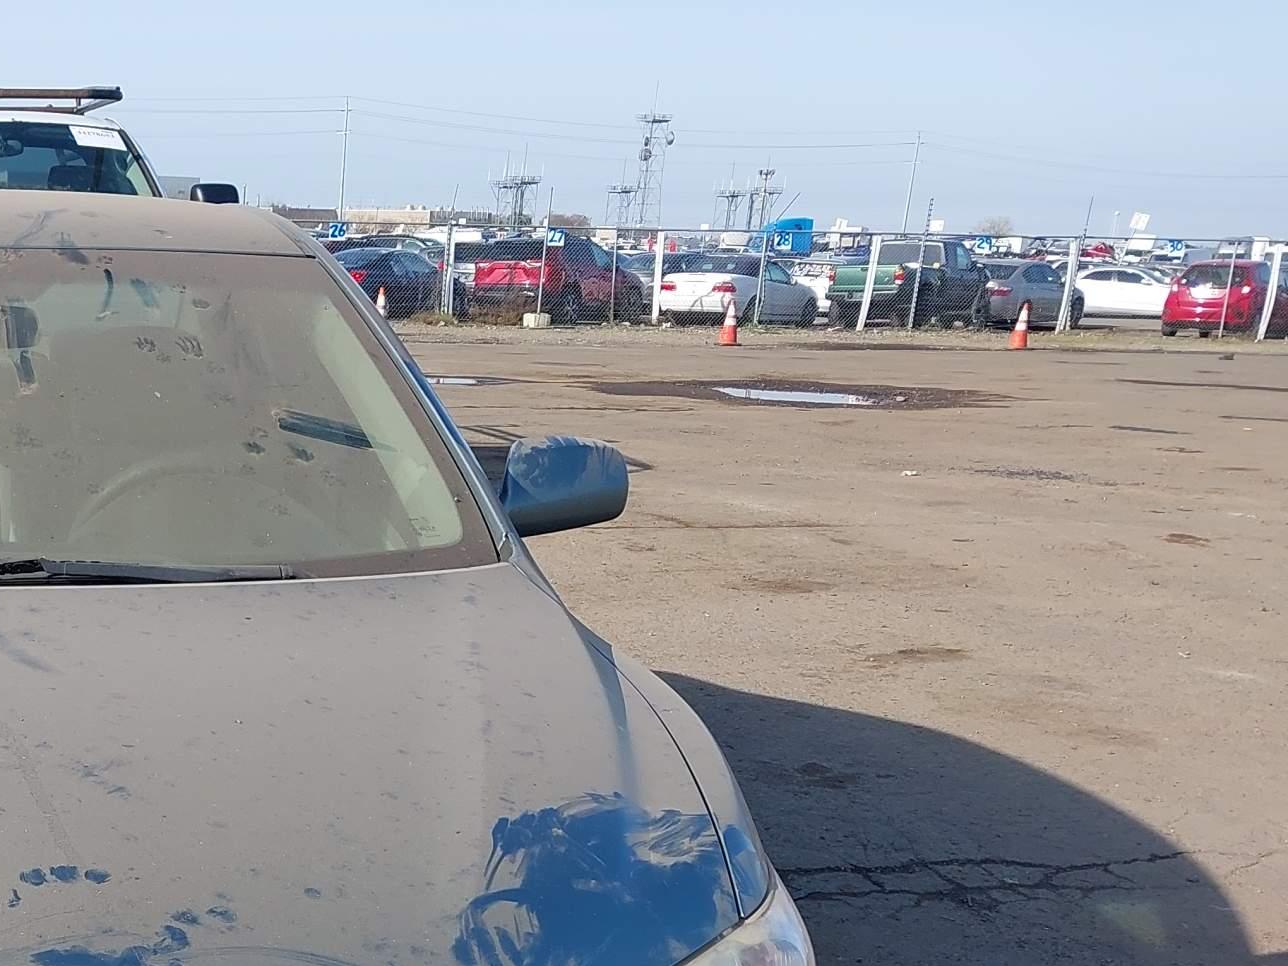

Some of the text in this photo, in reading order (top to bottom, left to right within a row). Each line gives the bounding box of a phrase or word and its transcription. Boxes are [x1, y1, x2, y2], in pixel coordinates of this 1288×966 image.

[330, 223, 346, 238] 26
[548, 228, 564, 243] 27
[776, 232, 791, 246] 28
[976, 237, 992, 250] 29
[1169, 240, 1183, 253] 30
